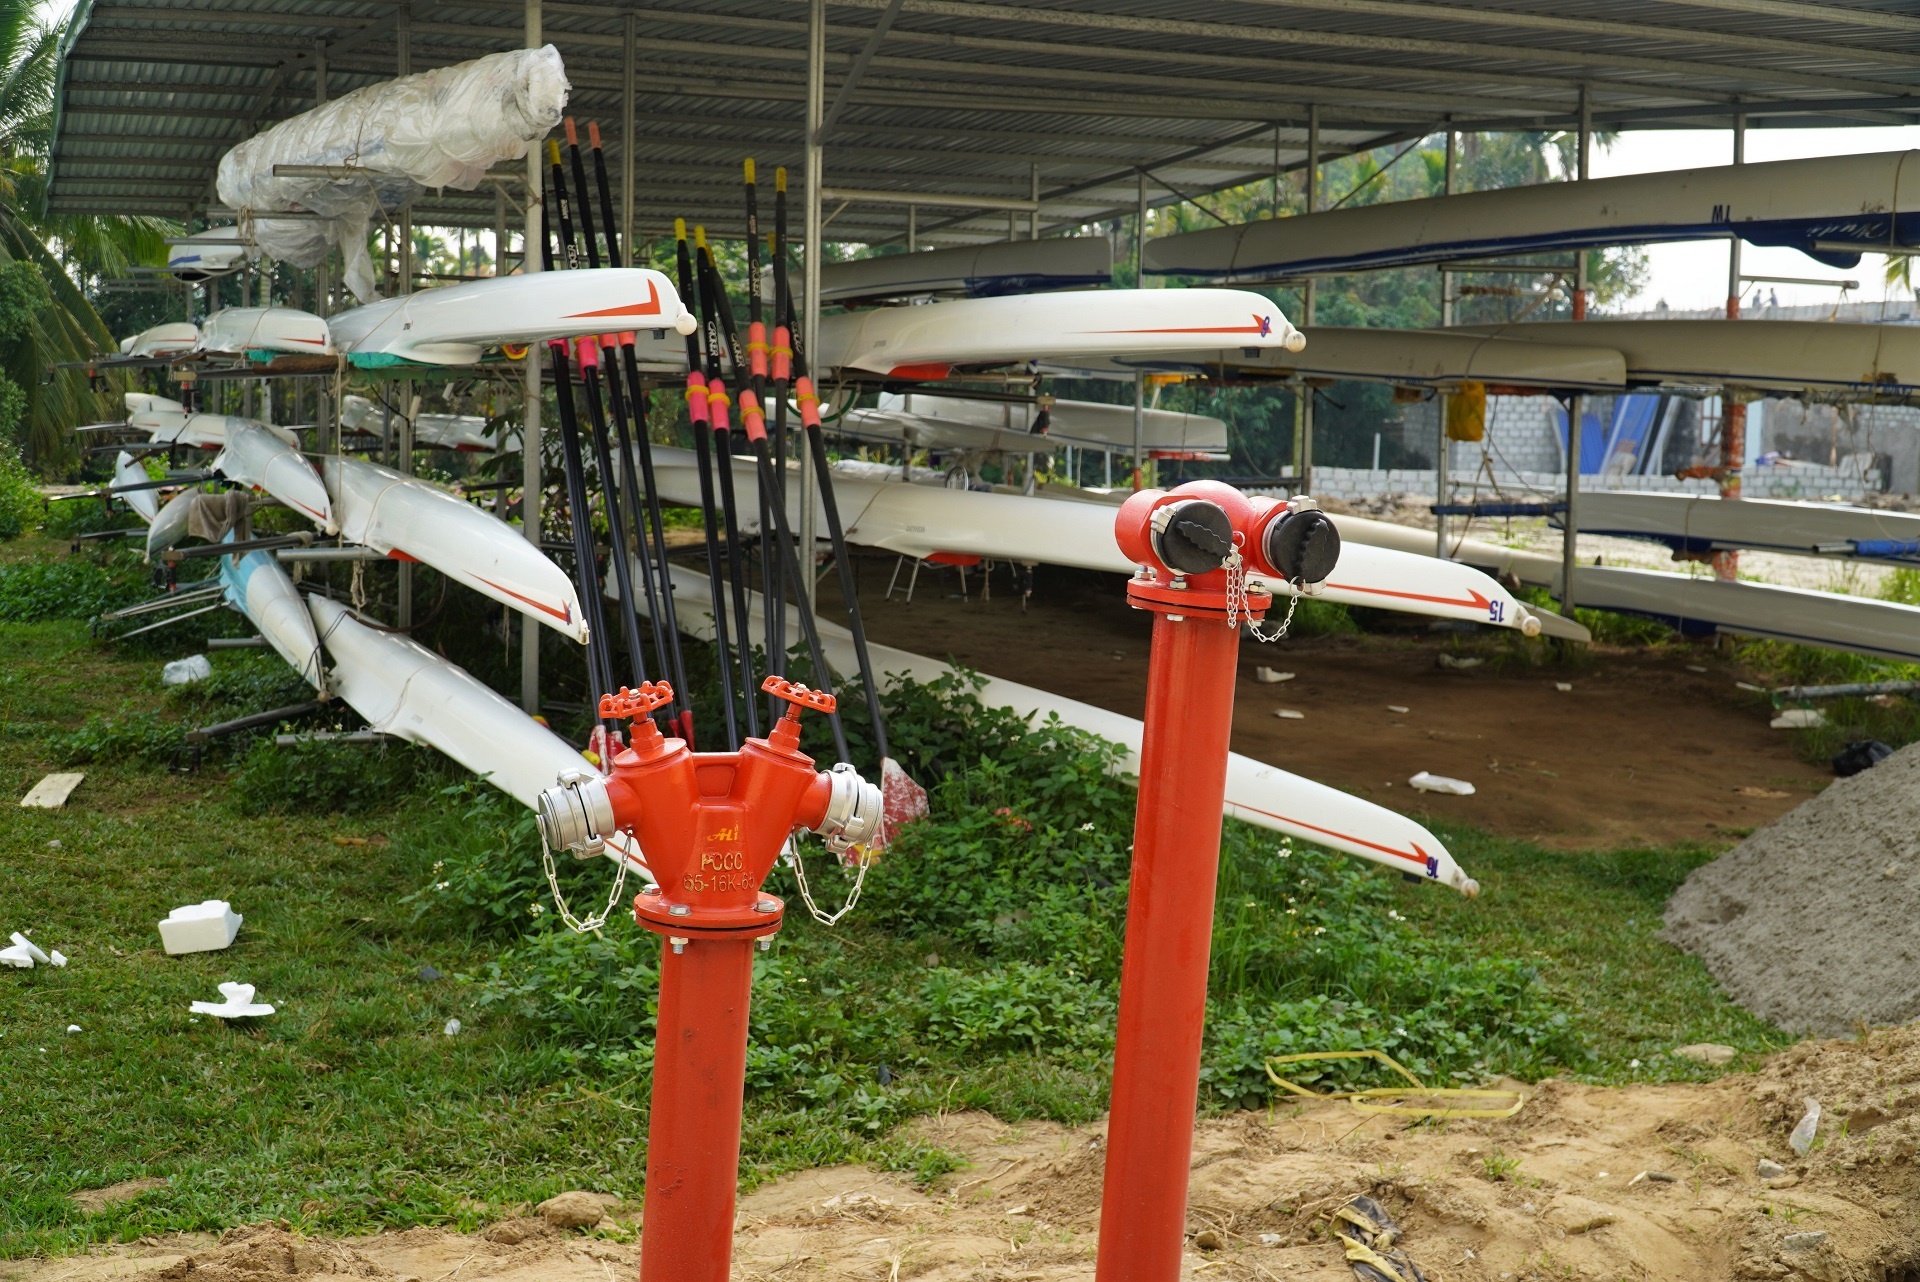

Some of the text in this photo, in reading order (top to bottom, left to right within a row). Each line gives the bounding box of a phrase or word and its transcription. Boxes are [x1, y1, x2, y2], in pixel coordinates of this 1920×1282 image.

[707, 320, 719, 357] CROKER
[730, 332, 746, 368] CROKER
[1489, 600, 1505, 623] 15
[683, 871, 755, 892] 65-16K-65
